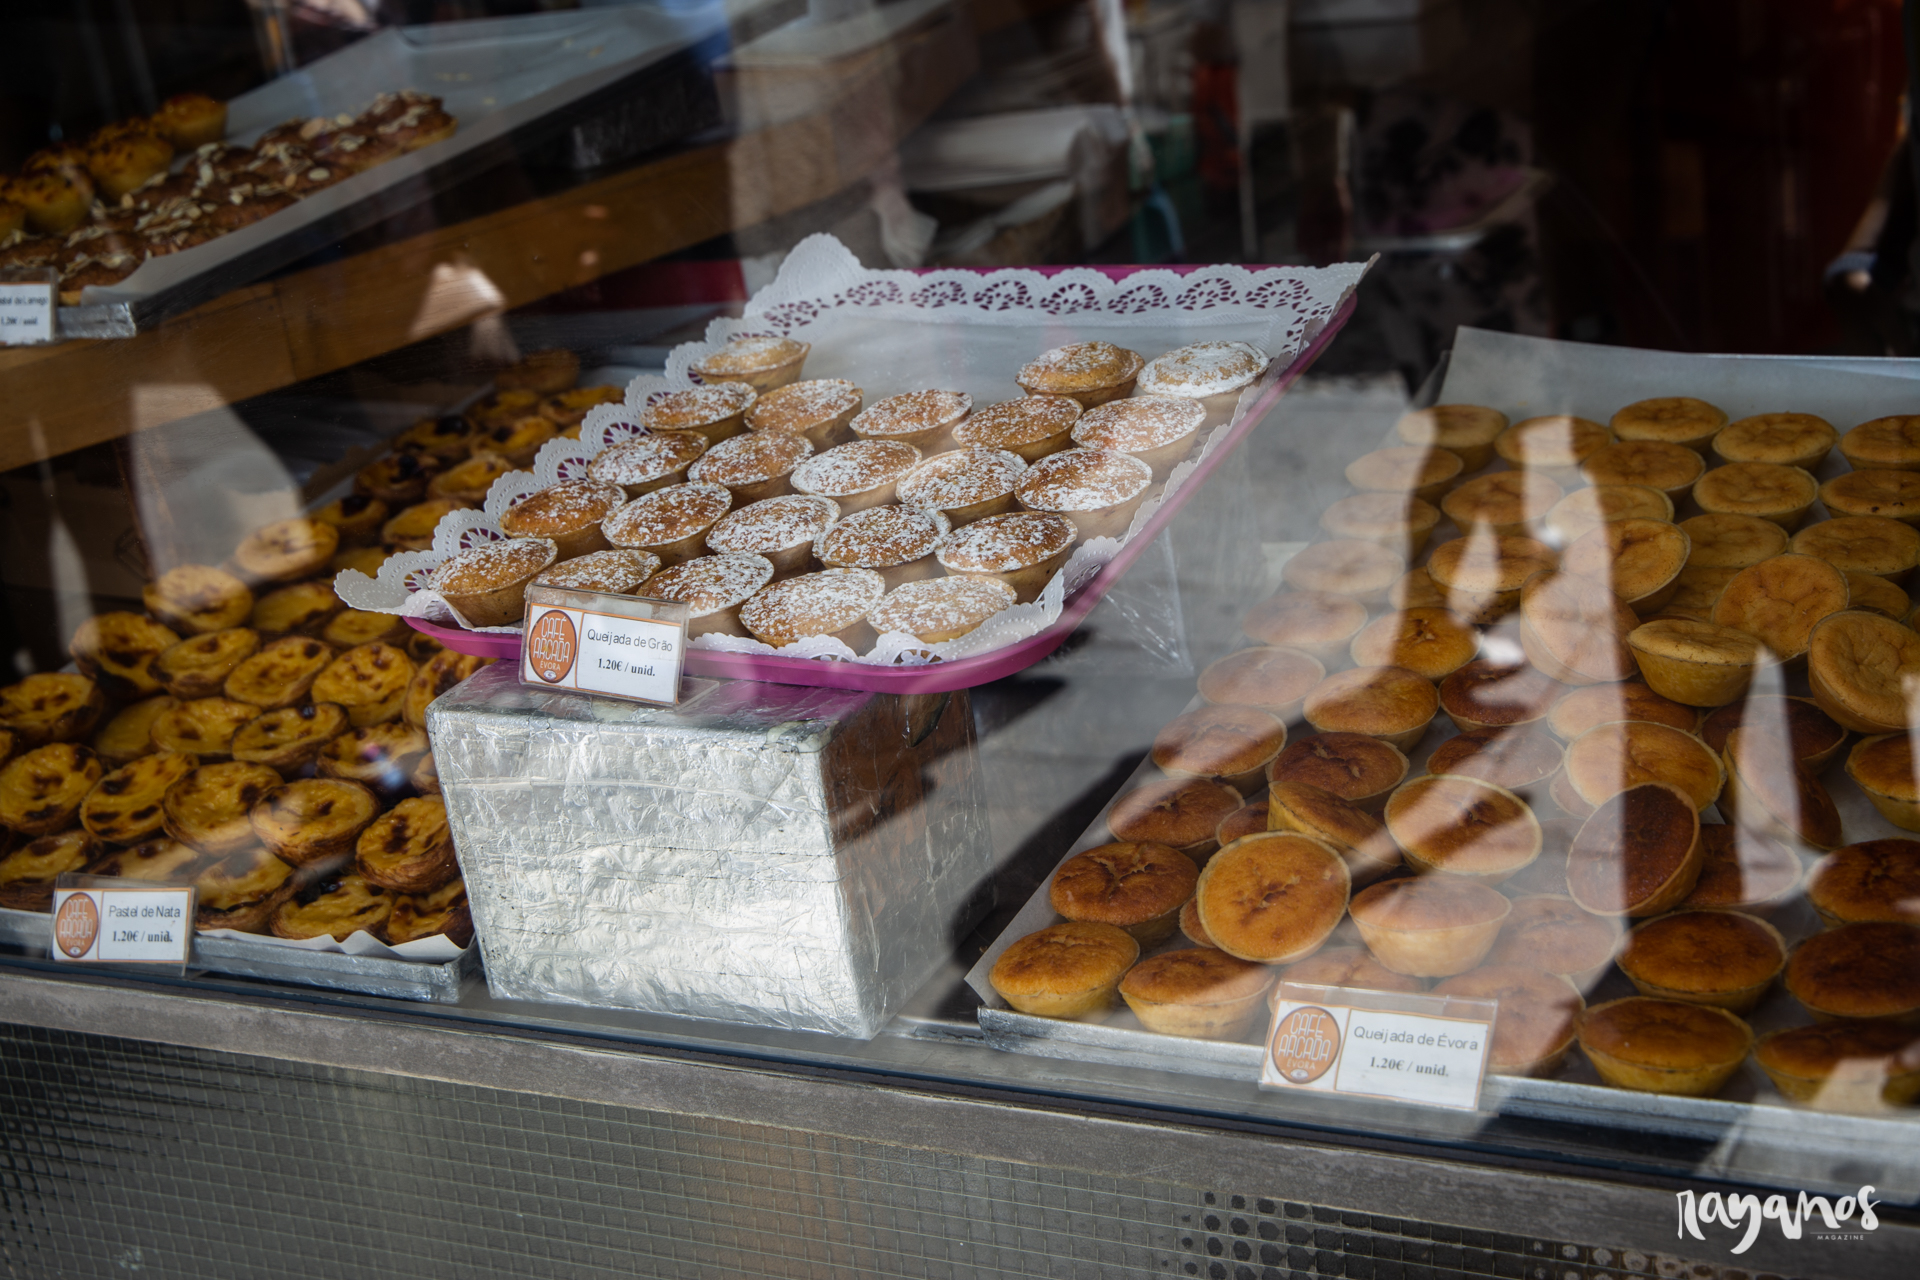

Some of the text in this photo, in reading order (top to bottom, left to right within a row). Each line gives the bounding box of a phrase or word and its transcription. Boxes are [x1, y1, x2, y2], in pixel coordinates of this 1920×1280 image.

[541, 616, 567, 641] CAFÉ
[533, 637, 571, 663] ARCADA
[587, 628, 673, 652] Queijada de Grão
[540, 659, 561, 671] ÉVORA
[598, 658, 623, 671] 1.20€
[631, 665, 656, 677] unid.
[65, 897, 89, 919] CAFÉ
[108, 905, 181, 918] Pastel de Nata
[59, 918, 93, 939] ARCADA
[112, 930, 139, 943] 1.20€
[147, 930, 173, 943] unid.
[1290, 1012, 1327, 1039] CAFÉ
[1278, 1034, 1332, 1062] ARCADA
[1353, 1026, 1479, 1051] Queijada de Évora
[1286, 1058, 1316, 1070] ÉVORA
[1369, 1056, 1405, 1071] 1.20€
[1415, 1061, 1450, 1078] unid.
